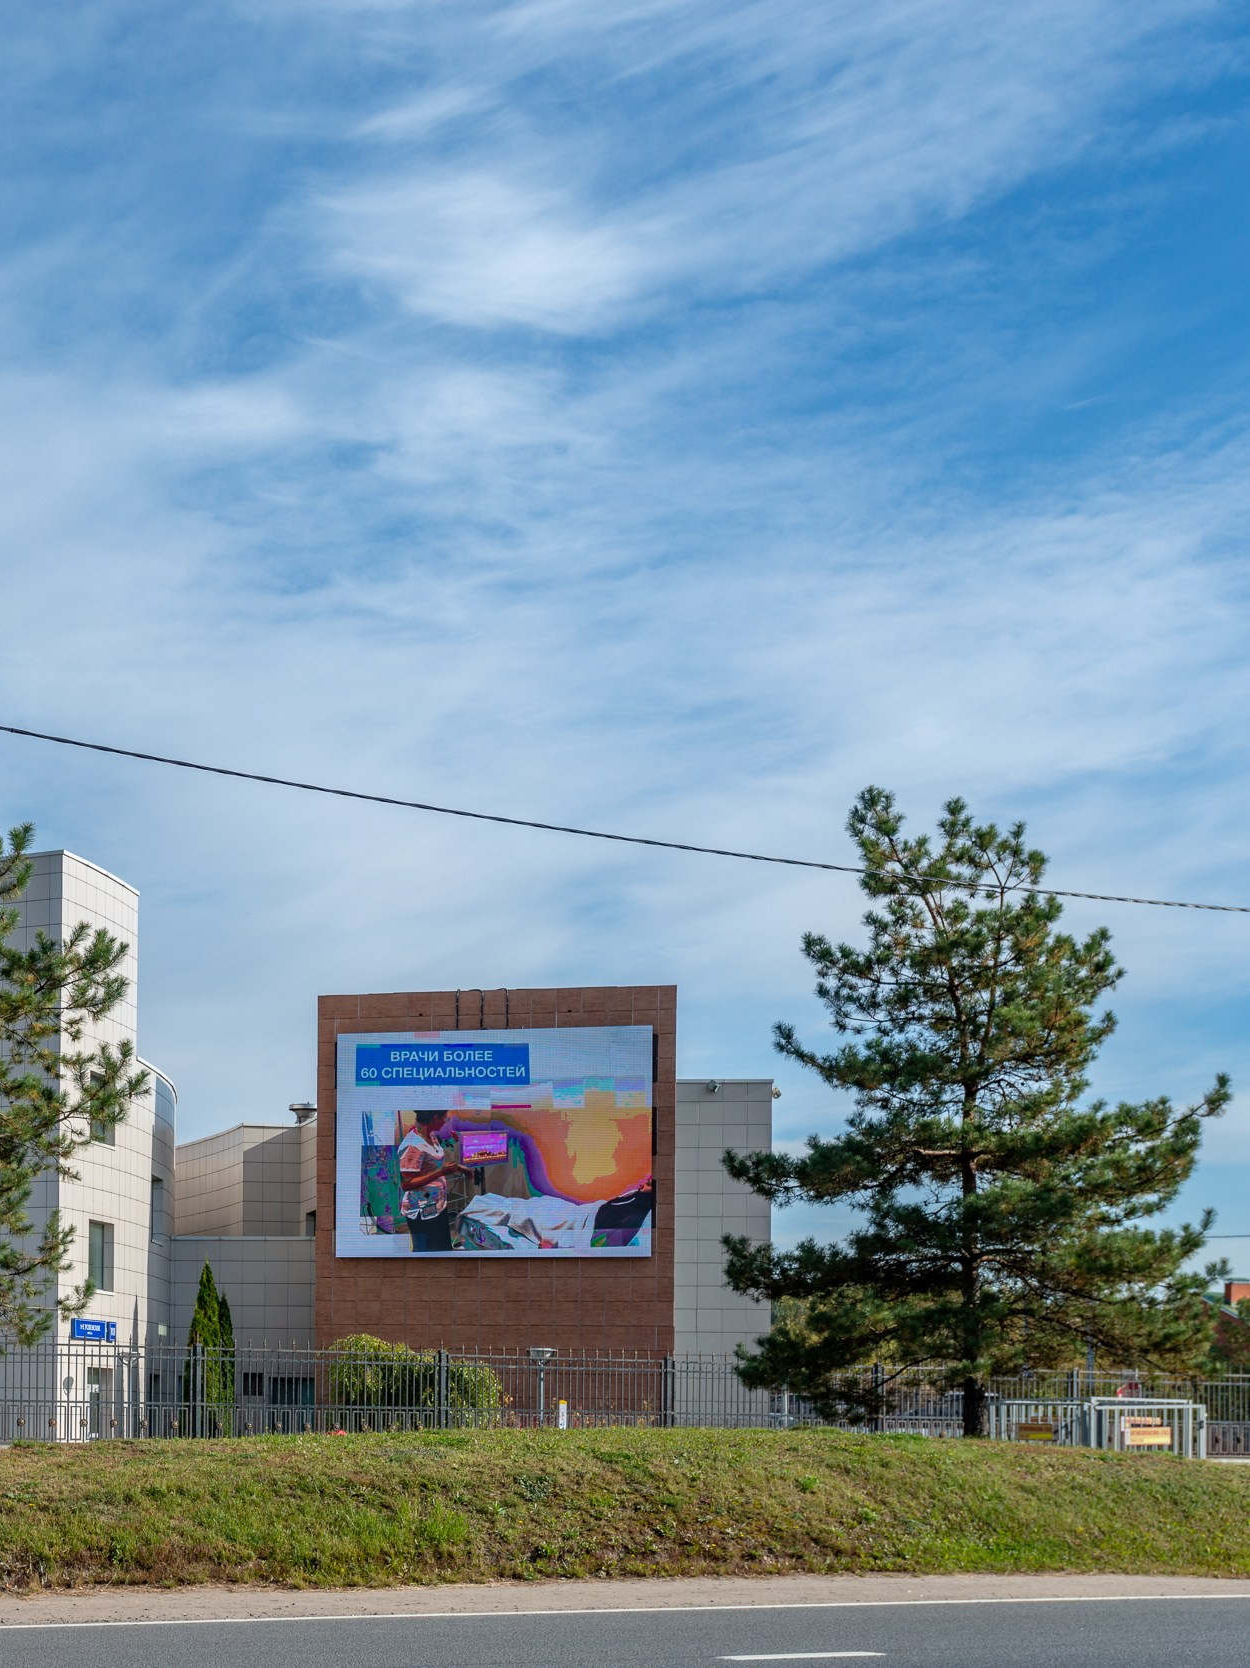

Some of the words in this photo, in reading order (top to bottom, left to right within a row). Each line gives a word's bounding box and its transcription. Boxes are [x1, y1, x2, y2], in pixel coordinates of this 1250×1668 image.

[390, 1051, 439, 1062] ВРАЧИ
[443, 1050, 493, 1062] БОЛЕЕ
[360, 1067, 377, 1079] 60
[381, 1064, 526, 1080] СПЕЦИАЛЬНОСТЕЙ
